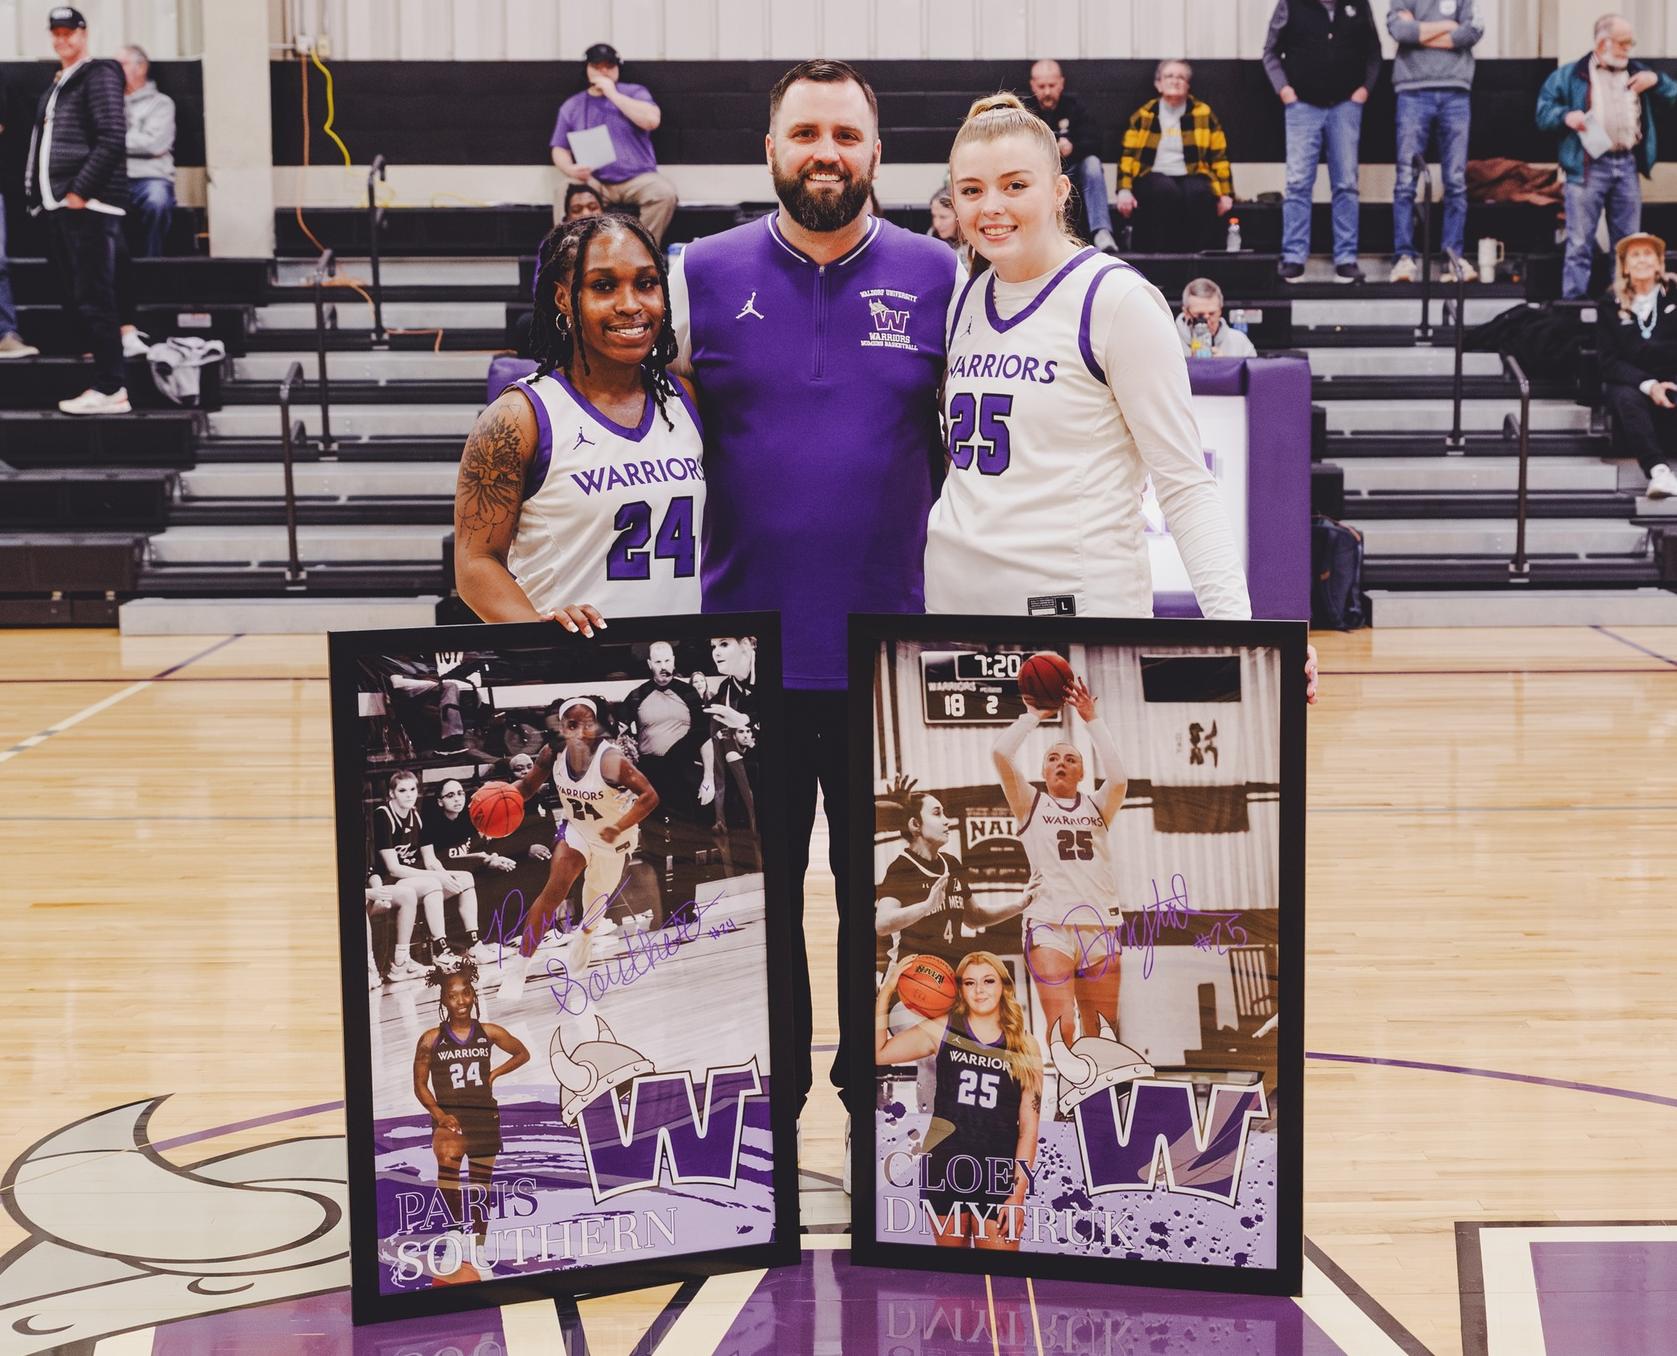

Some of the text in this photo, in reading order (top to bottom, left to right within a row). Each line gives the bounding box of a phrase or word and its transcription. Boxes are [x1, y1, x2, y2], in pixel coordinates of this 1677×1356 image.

[885, 289, 918, 303] UNIVERSITY
[868, 332, 911, 344] WARRIORS
[950, 392, 1014, 477] 25
[606, 495, 696, 581] 24
[1061, 601, 1069, 611] L
[974, 654, 1021, 678] 7:20
[944, 693, 999, 717] 18 2
[970, 820, 1014, 842] NAI
[1042, 815, 1105, 828] WARRIORS
[1056, 829, 1095, 861] 25
[943, 919, 953, 944] 4
[437, 1047, 489, 1061] WARRIORS
[949, 1050, 1013, 1072] WARRIOR
[449, 1061, 484, 1090] 24
[957, 1069, 1001, 1110] 25
[576, 1053, 763, 1206] W
[1074, 1079, 1270, 1210] W
[883, 1151, 1047, 1197] CLOEY
[395, 1177, 539, 1234] PARIS
[883, 1196, 1136, 1250] DMYTRUK
[397, 1207, 678, 1281] SOUTHERN
